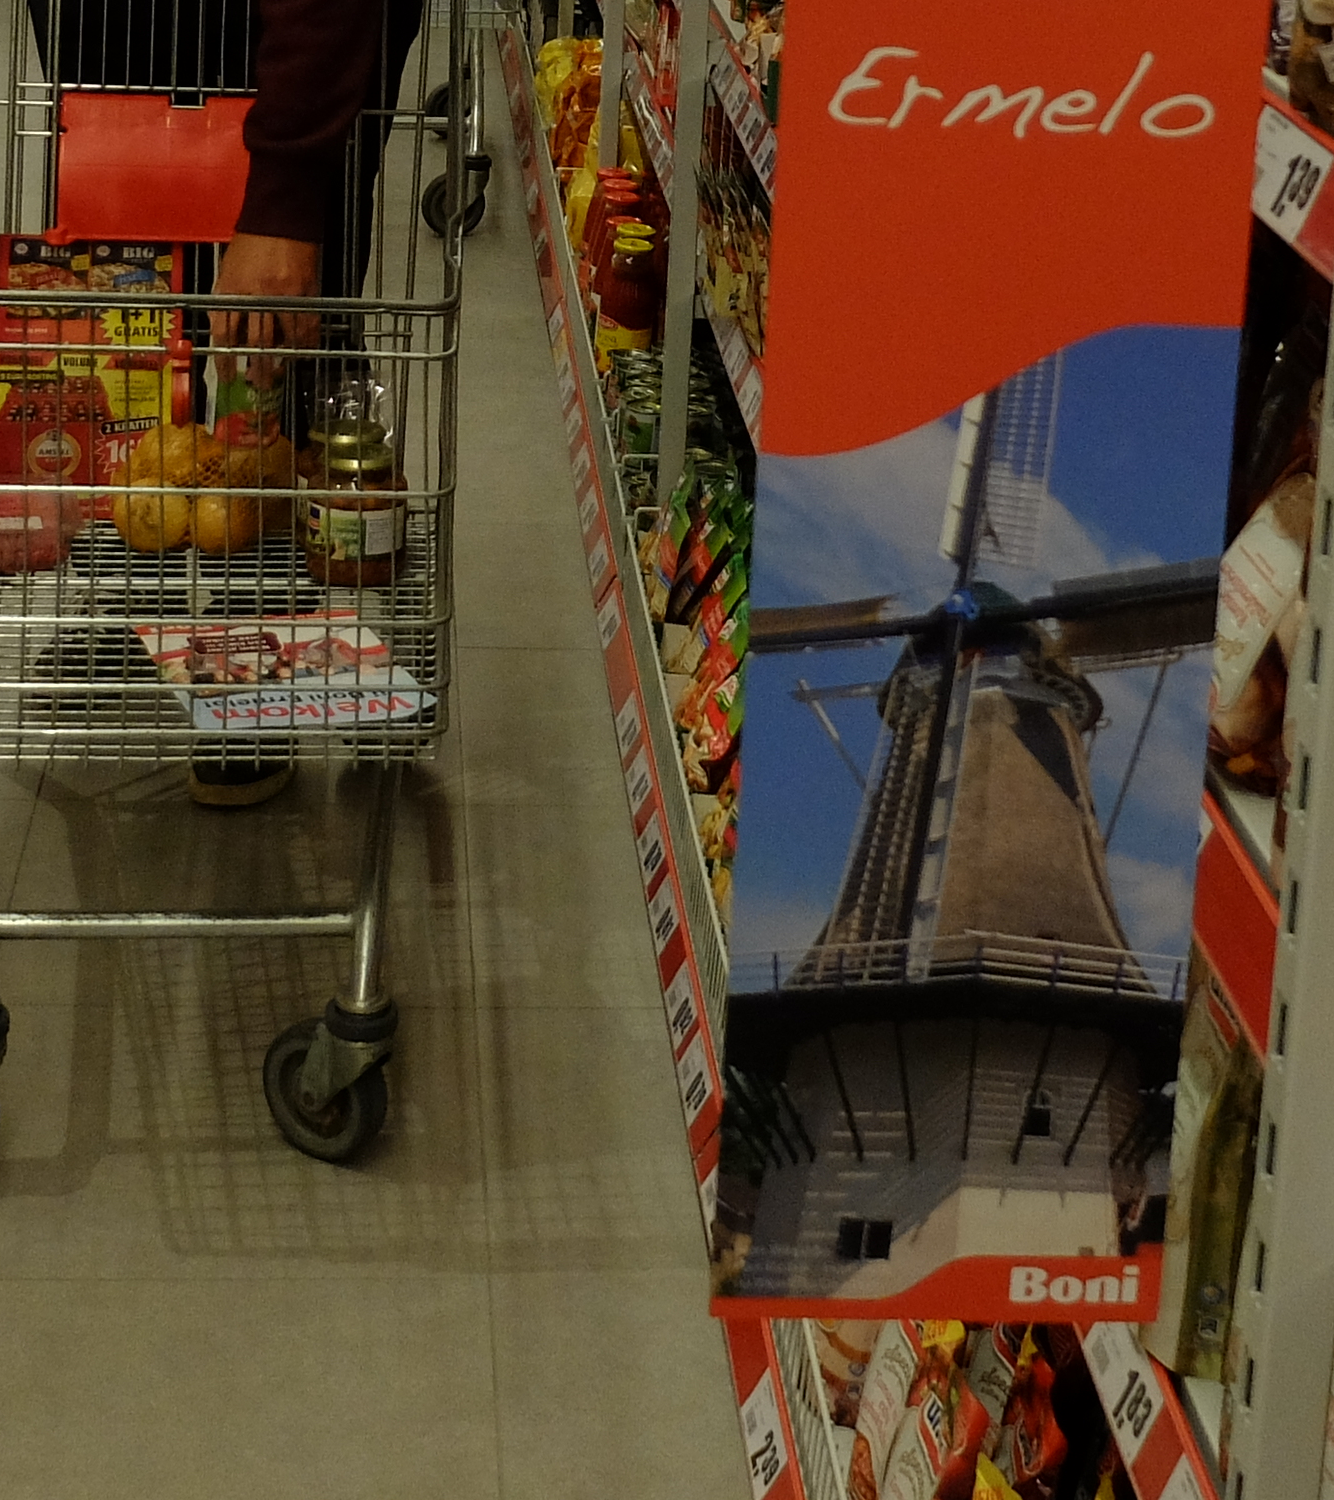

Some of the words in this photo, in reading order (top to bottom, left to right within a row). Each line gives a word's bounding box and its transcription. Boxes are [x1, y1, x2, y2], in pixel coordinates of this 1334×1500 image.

[828, 46, 1215, 138] Ermelo
[123, 246, 155, 259] BIG
[1009, 1264, 1140, 1303] Boni
